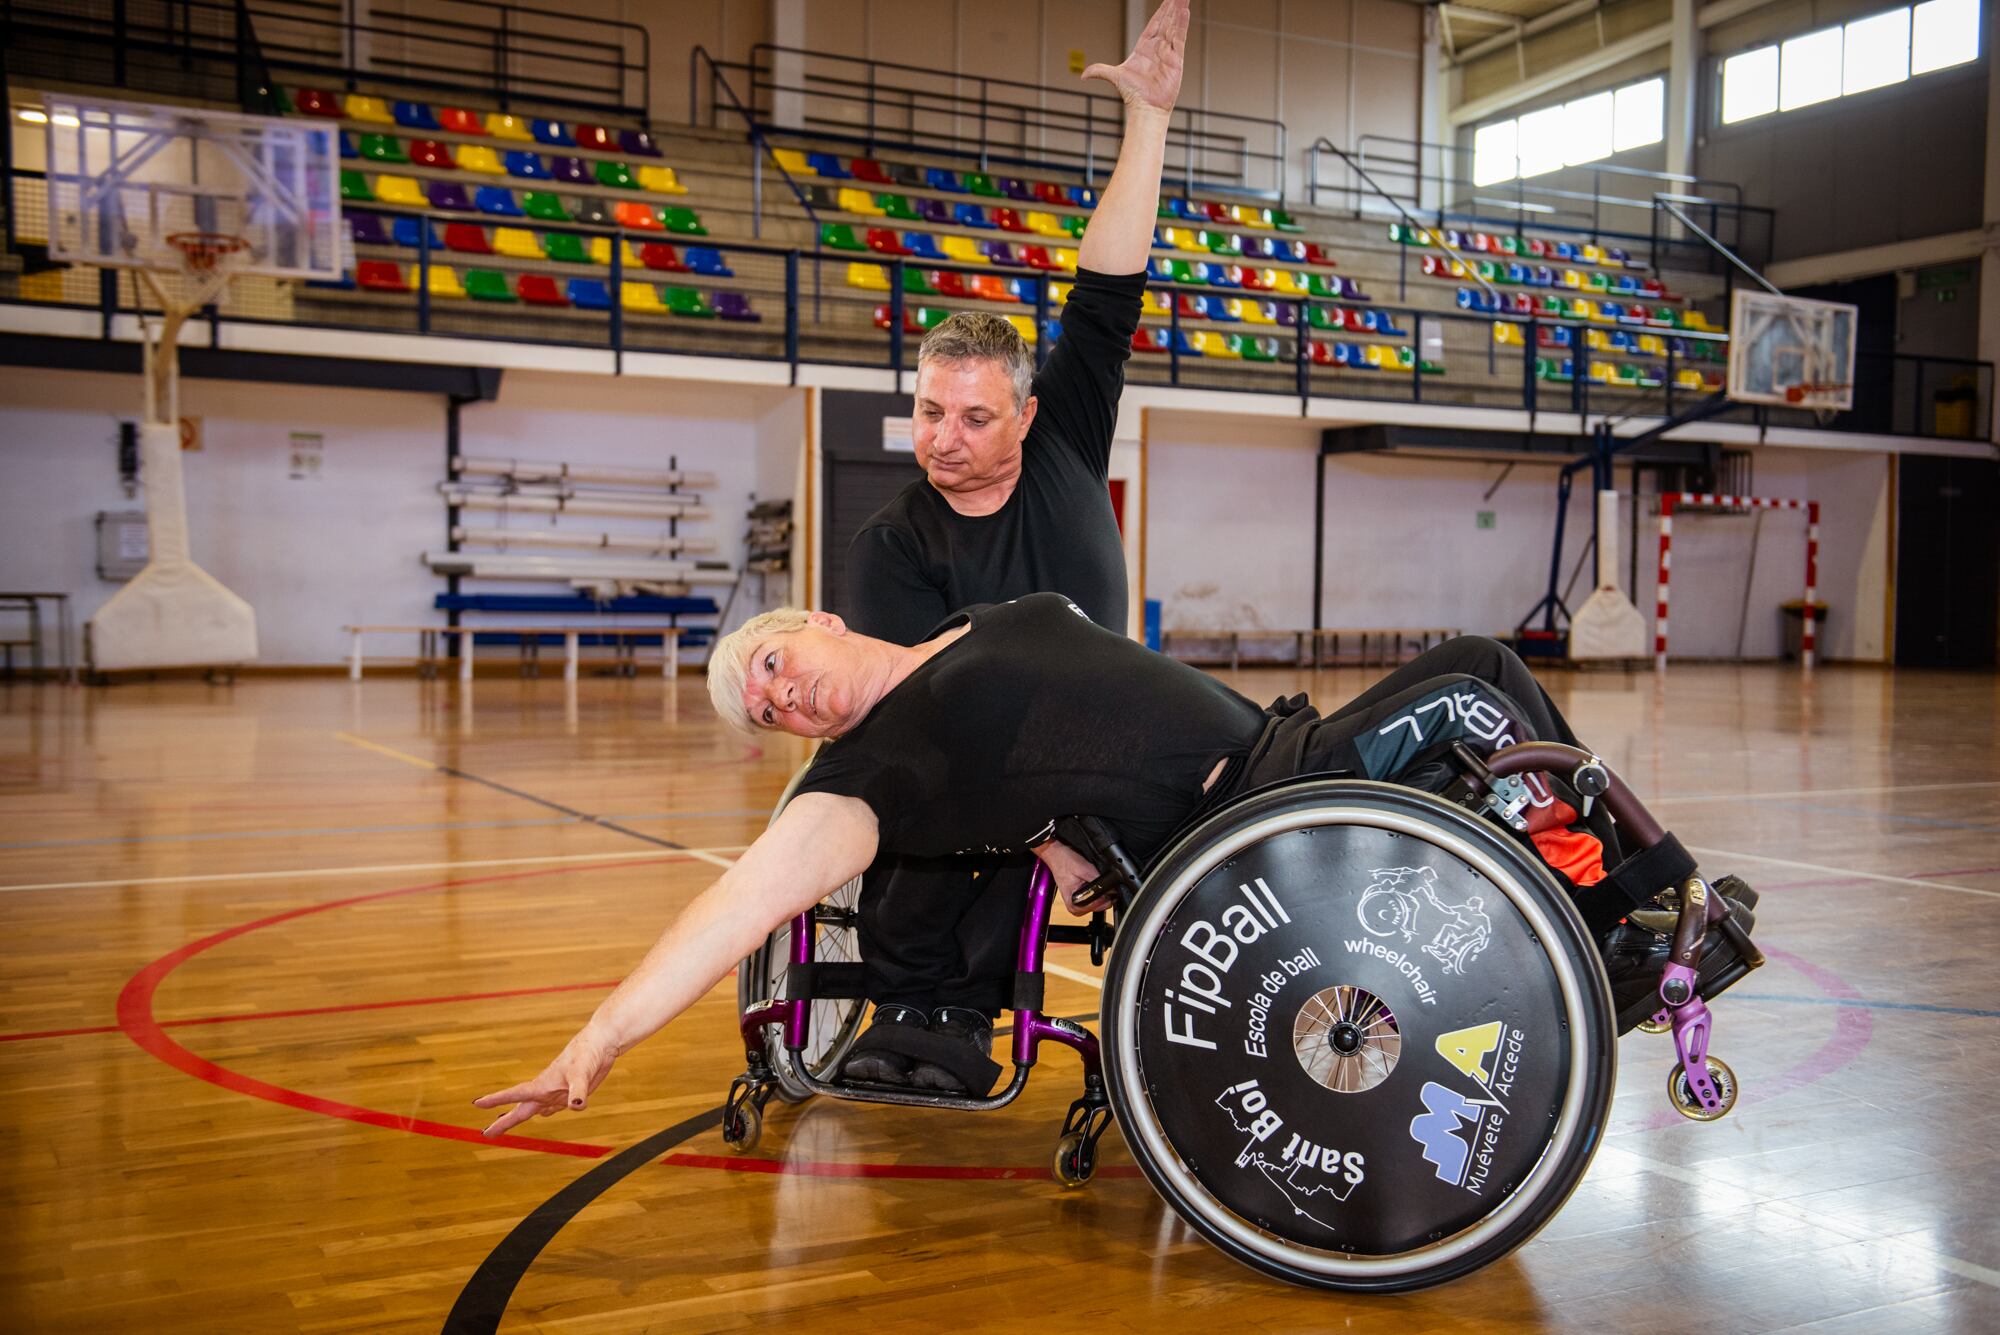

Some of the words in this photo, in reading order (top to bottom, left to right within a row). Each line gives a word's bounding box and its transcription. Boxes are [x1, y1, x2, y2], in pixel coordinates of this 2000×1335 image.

[1163, 877, 1292, 1051] FipBall
[1243, 991, 1273, 1059] Escola
[1259, 969, 1288, 995] de
[1277, 946, 1322, 978] ball
[1343, 937, 1437, 1006] wheelchair
[1227, 1078, 1284, 1143] Boi
[1465, 1113, 1503, 1196] Muévete
[1495, 1029, 1525, 1097] Accede
[1281, 1131, 1365, 1185] Sant
